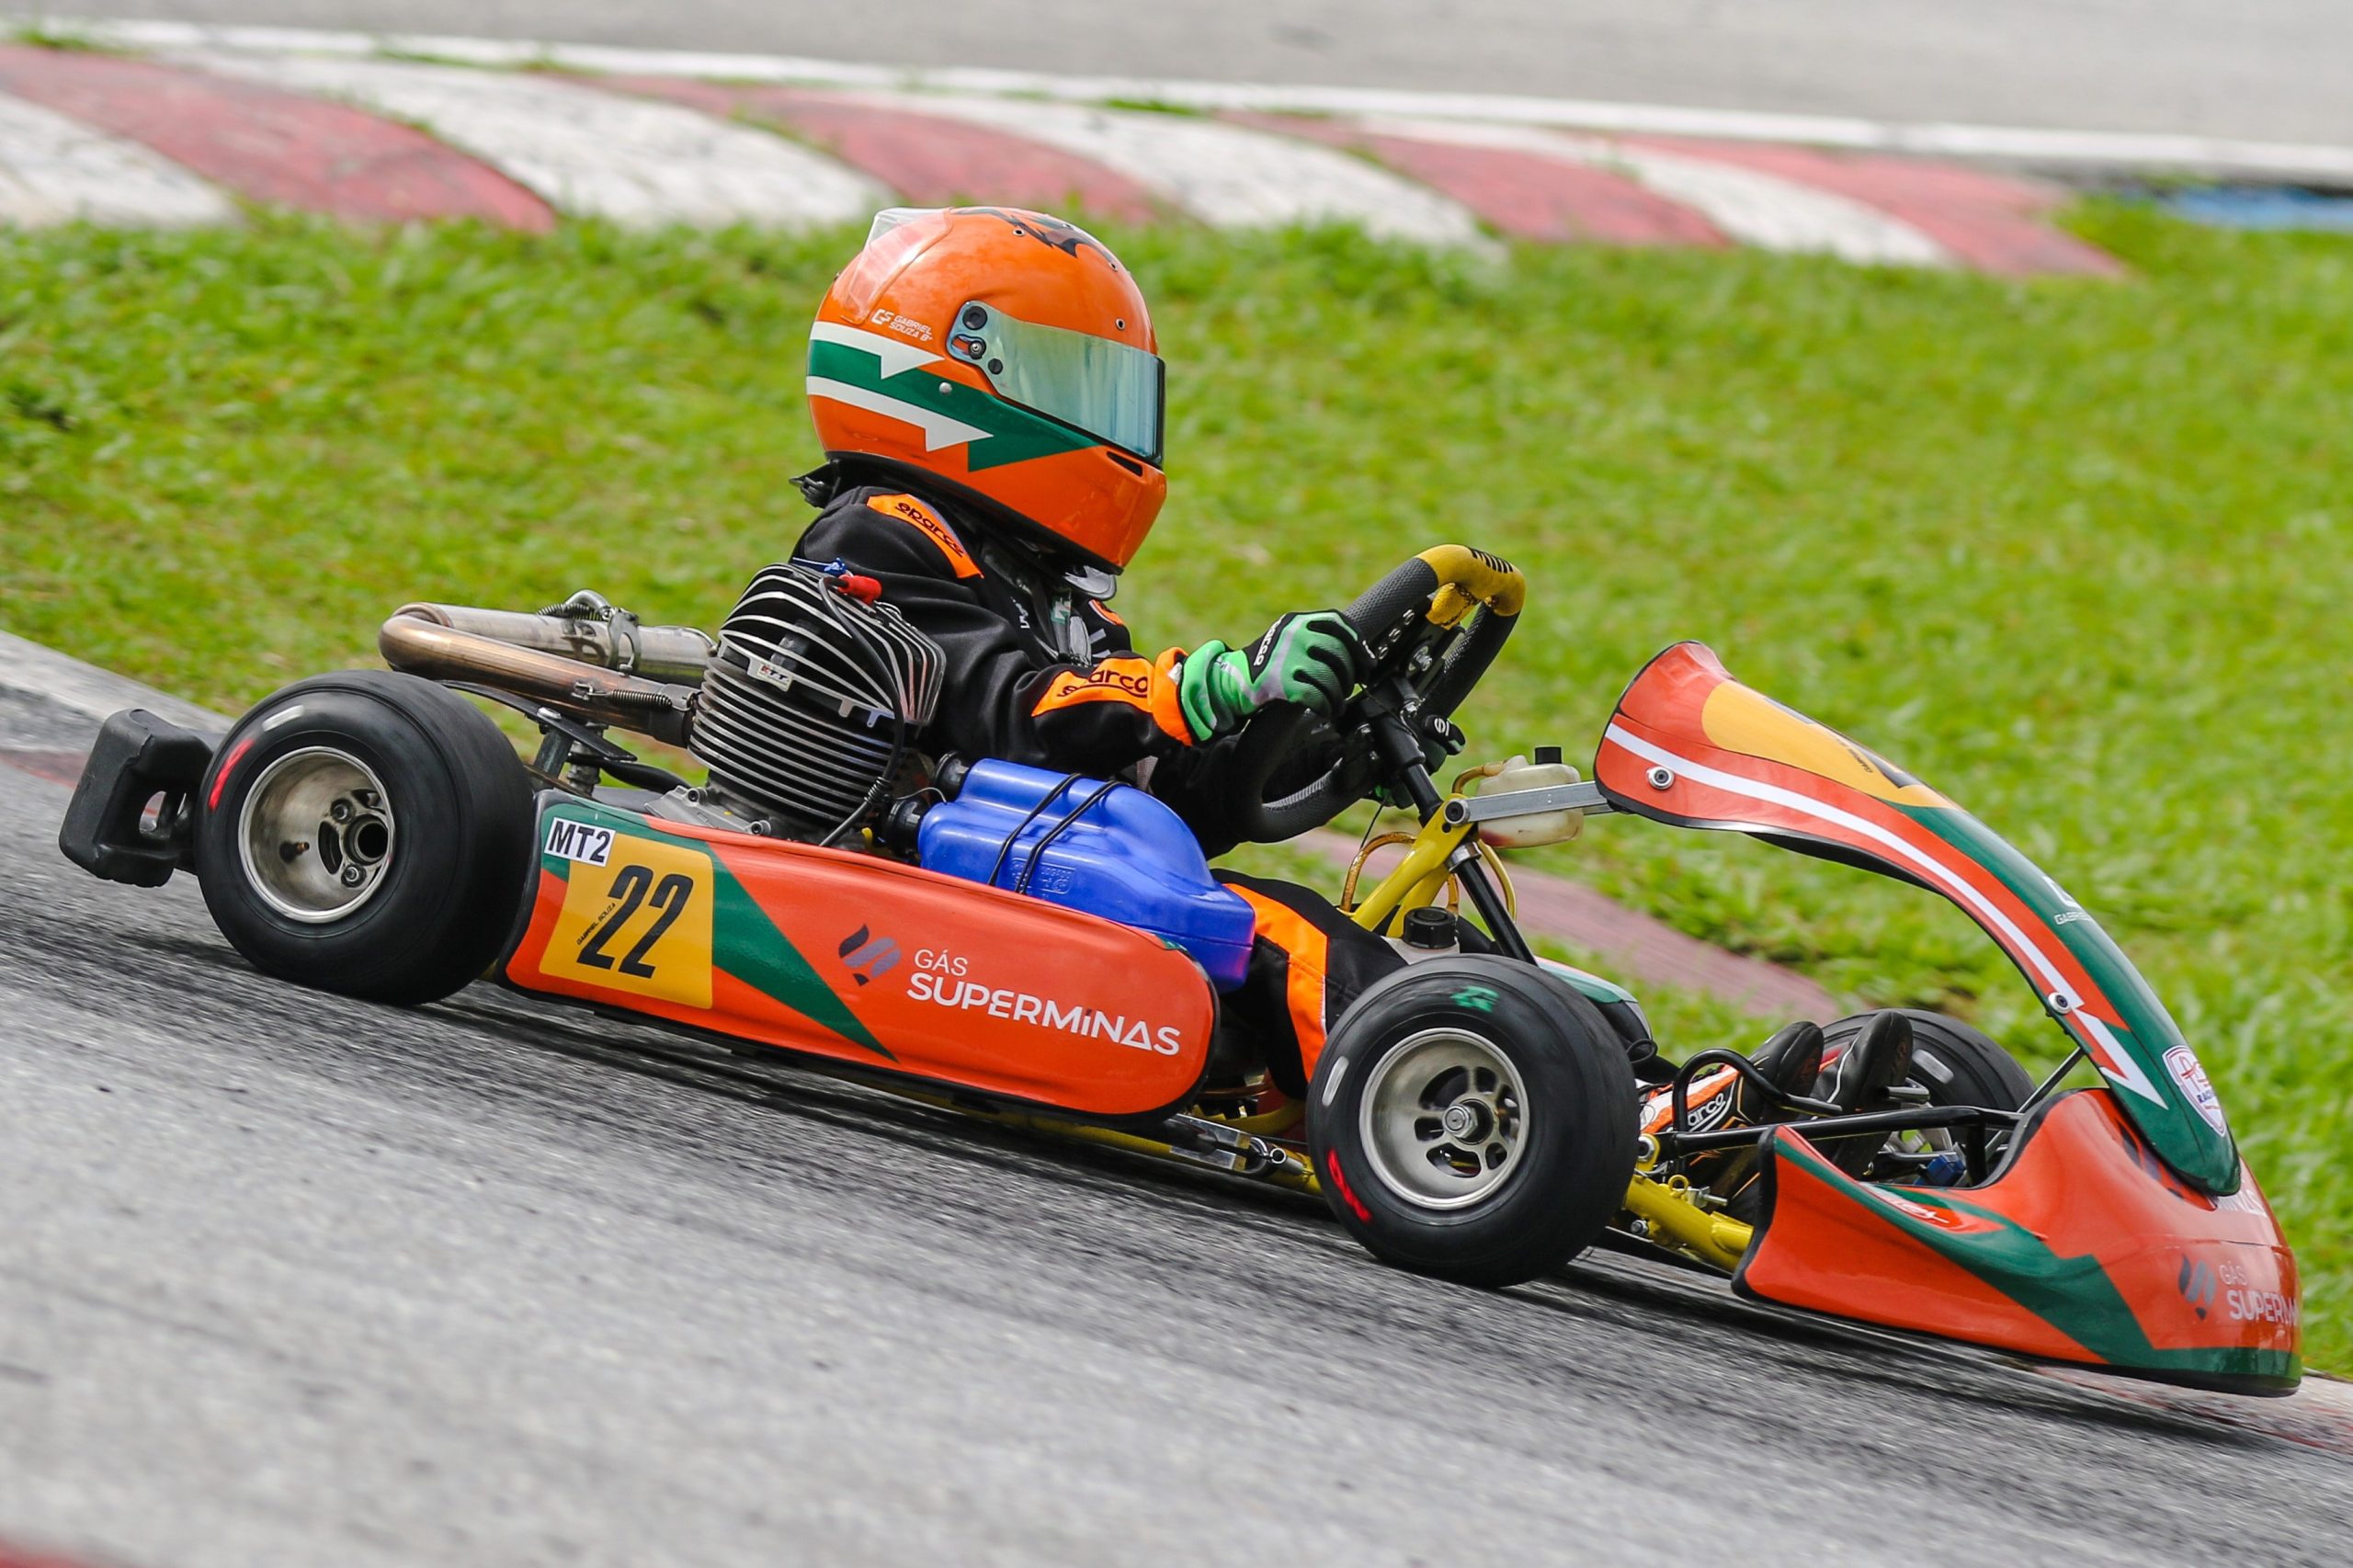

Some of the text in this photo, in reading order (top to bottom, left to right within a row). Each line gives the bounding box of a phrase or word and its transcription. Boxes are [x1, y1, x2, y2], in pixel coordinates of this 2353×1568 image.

[888, 321, 920, 338] SOUZA
[893, 314, 933, 335] GABRIEL
[1057, 669, 1149, 699] sarco
[548, 820, 611, 863] MT2
[575, 864, 694, 980] 22
[914, 949, 969, 977] GÁS
[1688, 1092, 1724, 1127] arco
[2219, 1259, 2248, 1287] GÁS
